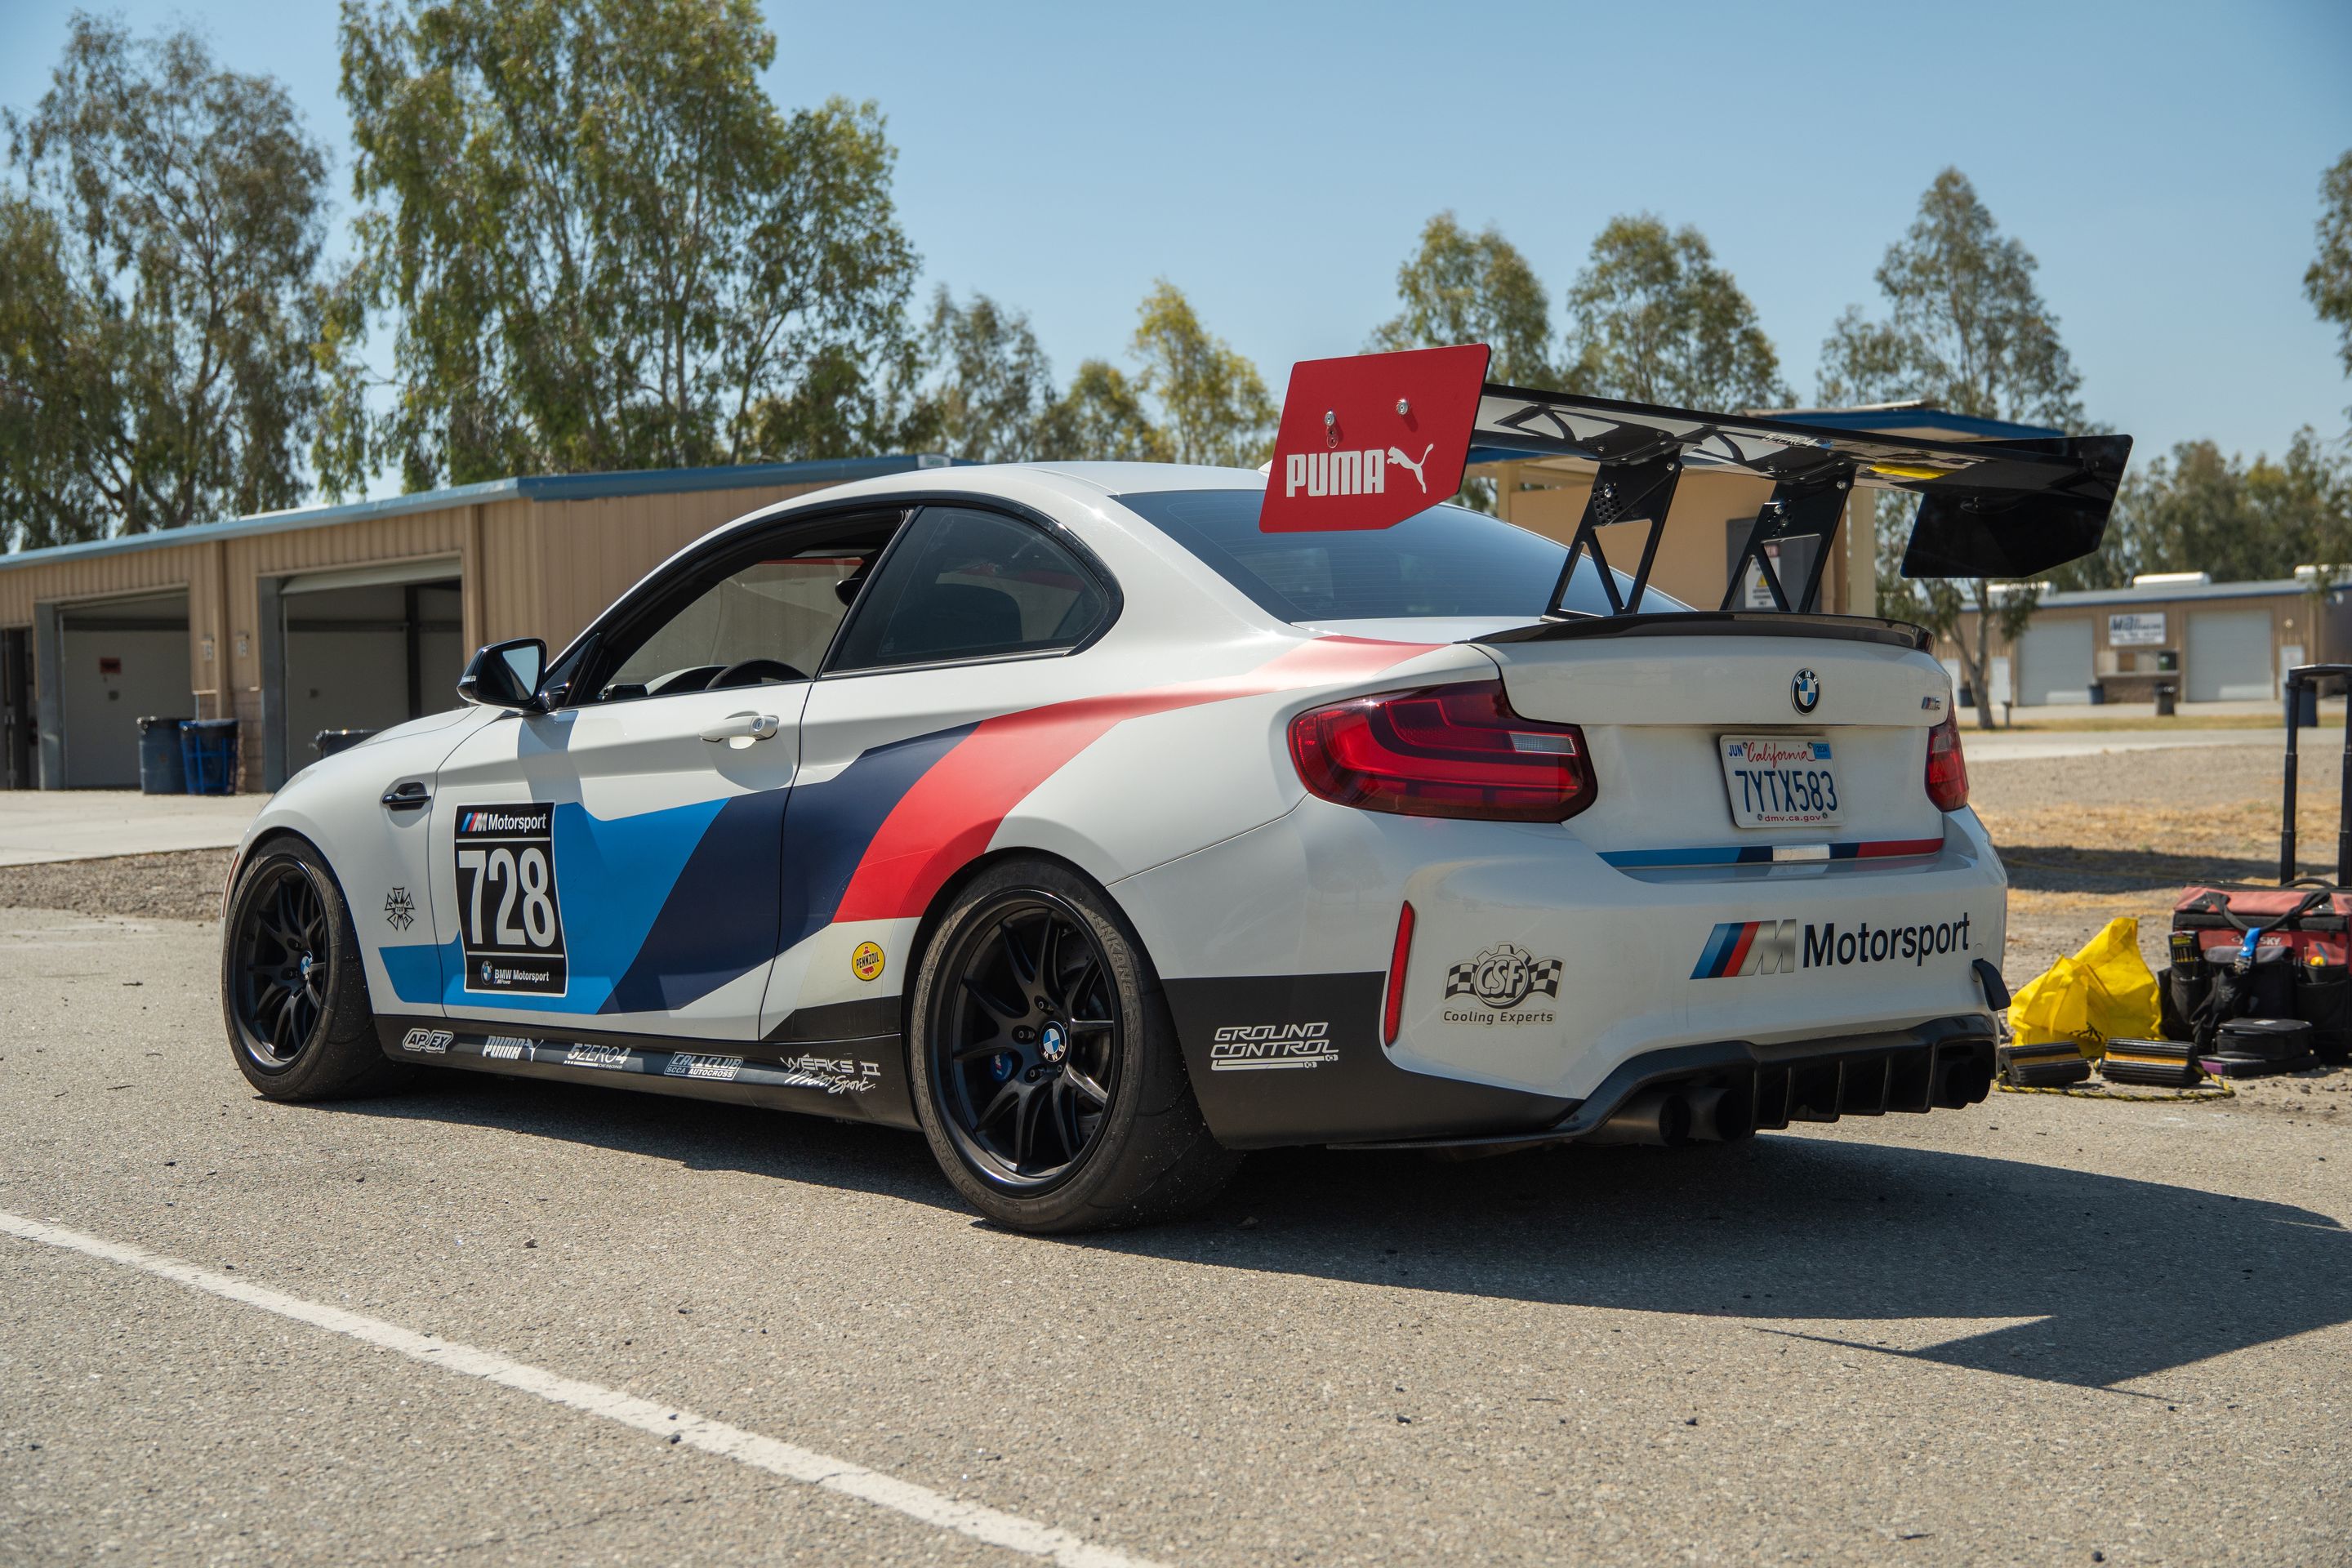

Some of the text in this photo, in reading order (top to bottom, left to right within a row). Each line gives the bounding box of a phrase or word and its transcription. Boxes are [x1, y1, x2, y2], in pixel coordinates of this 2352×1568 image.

[1286, 449, 1384, 497] PUMA
[1797, 670, 1819, 685] BMW
[1729, 744, 1744, 757] JUN
[1747, 742, 1816, 768] California
[1735, 770, 1838, 813] 7YTX583
[488, 813, 546, 833] Motorsport
[458, 847, 555, 947] 728
[1802, 912, 1970, 969] Motorsport
[856, 951, 880, 969] PENNZOIL
[494, 969, 550, 983] BMW Motorsport
[1481, 959, 1525, 997] CSF
[1444, 1011, 1553, 1025] Cooling Experts
[1214, 1022, 1329, 1041] GROUND
[407, 1032, 450, 1051] APEX
[483, 1035, 526, 1060] PUMA
[1210, 1039, 1339, 1058] CONTROL
[567, 1042, 632, 1064] 5ZERO4
[666, 1066, 734, 1078] SCCA AUTOCROSS
[705, 1057, 742, 1070] CLUB
[860, 1060, 881, 1076] II
